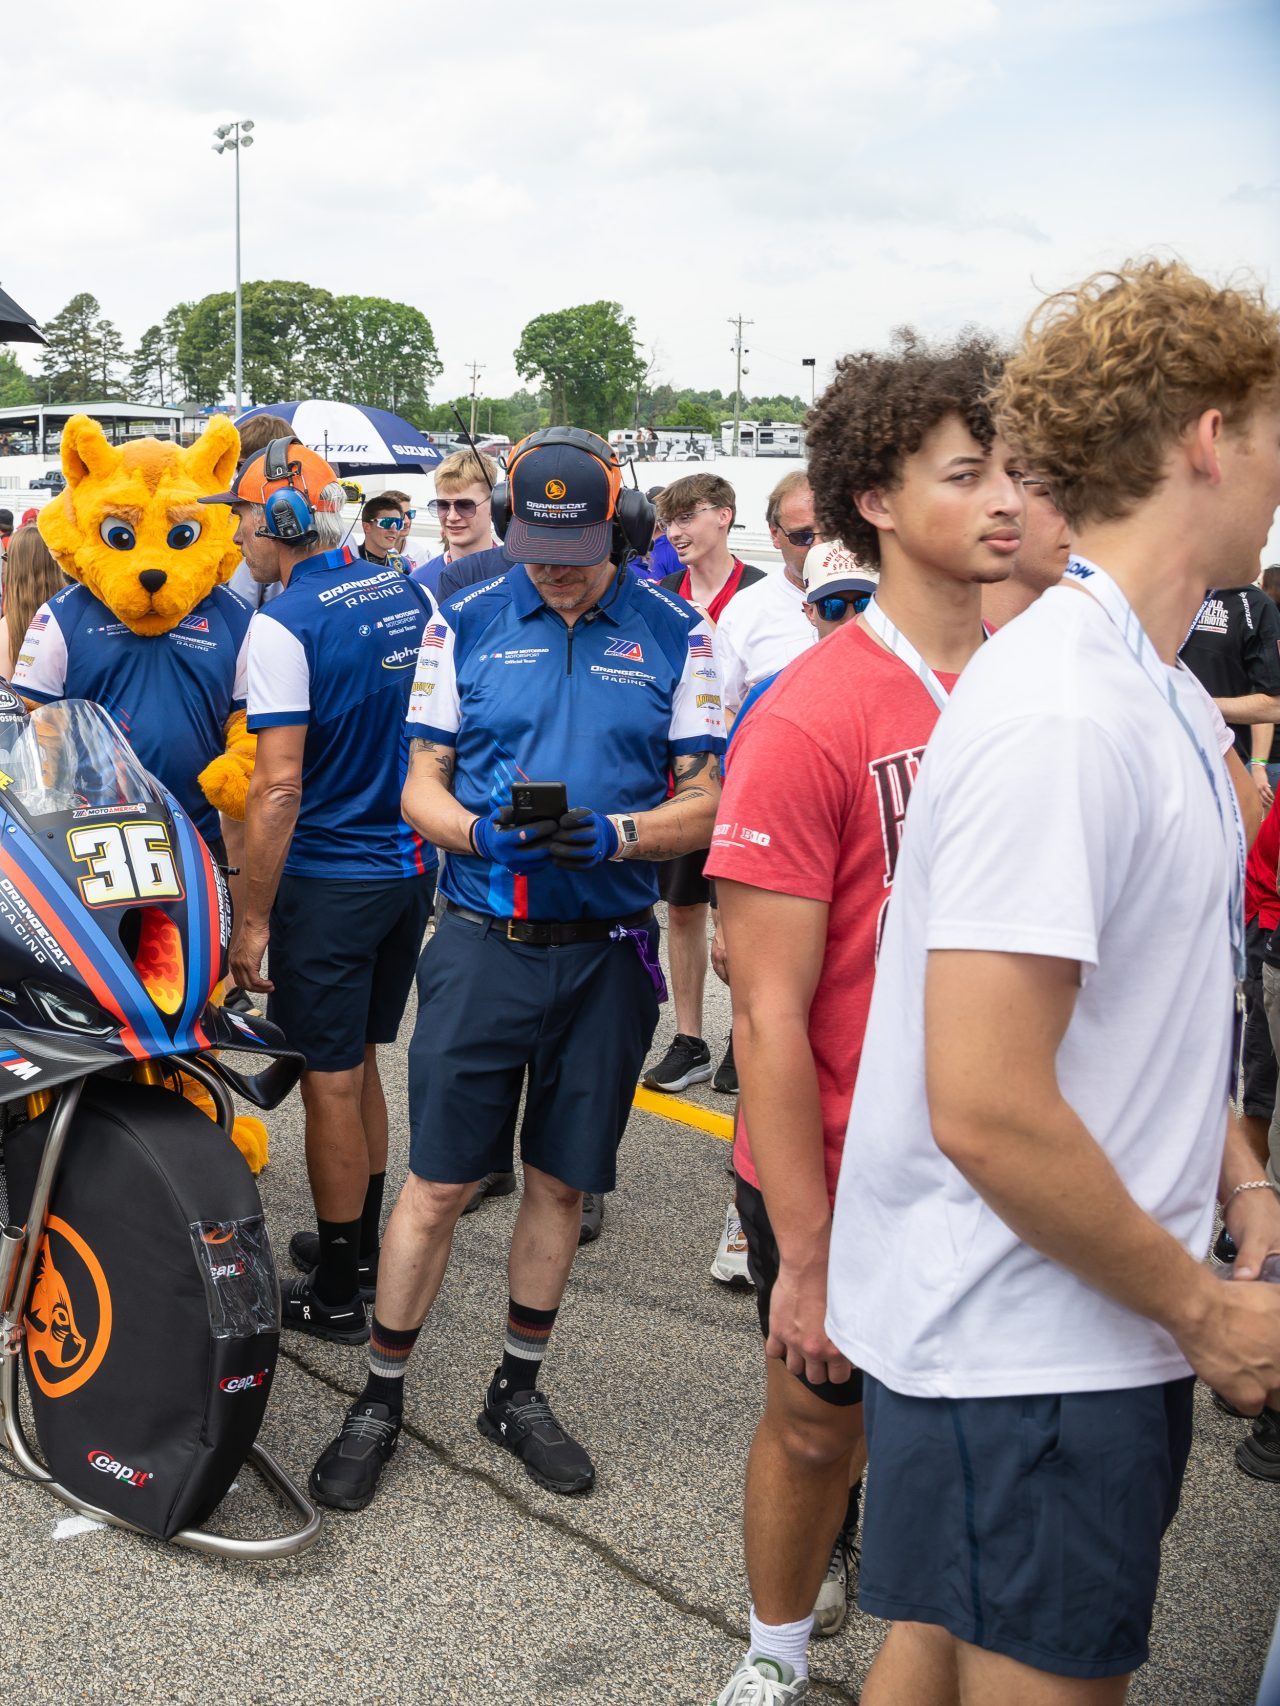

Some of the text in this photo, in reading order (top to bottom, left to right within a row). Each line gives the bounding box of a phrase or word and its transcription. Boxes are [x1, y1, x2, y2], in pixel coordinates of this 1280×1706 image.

[392, 444, 438, 458] SUZUKI
[526, 501, 588, 510] ORANGECAT
[533, 511, 578, 519] RACING
[318, 571, 401, 602] ORANGECAT
[463, 576, 506, 604] DUNLOP
[345, 584, 405, 609] RACING
[647, 587, 690, 619] DUNLOP
[1208, 599, 1225, 610] OLD.
[385, 616, 417, 628] MOTORSPORT
[388, 625, 417, 636] Official Team
[176, 640, 209, 652] RACING
[590, 665, 657, 680] ORANGECAT
[601, 675, 647, 687] RACING
[67, 822, 186, 909] 36
[0, 878, 72, 968] ORANGECAT
[93, 1452, 150, 1488] capit
